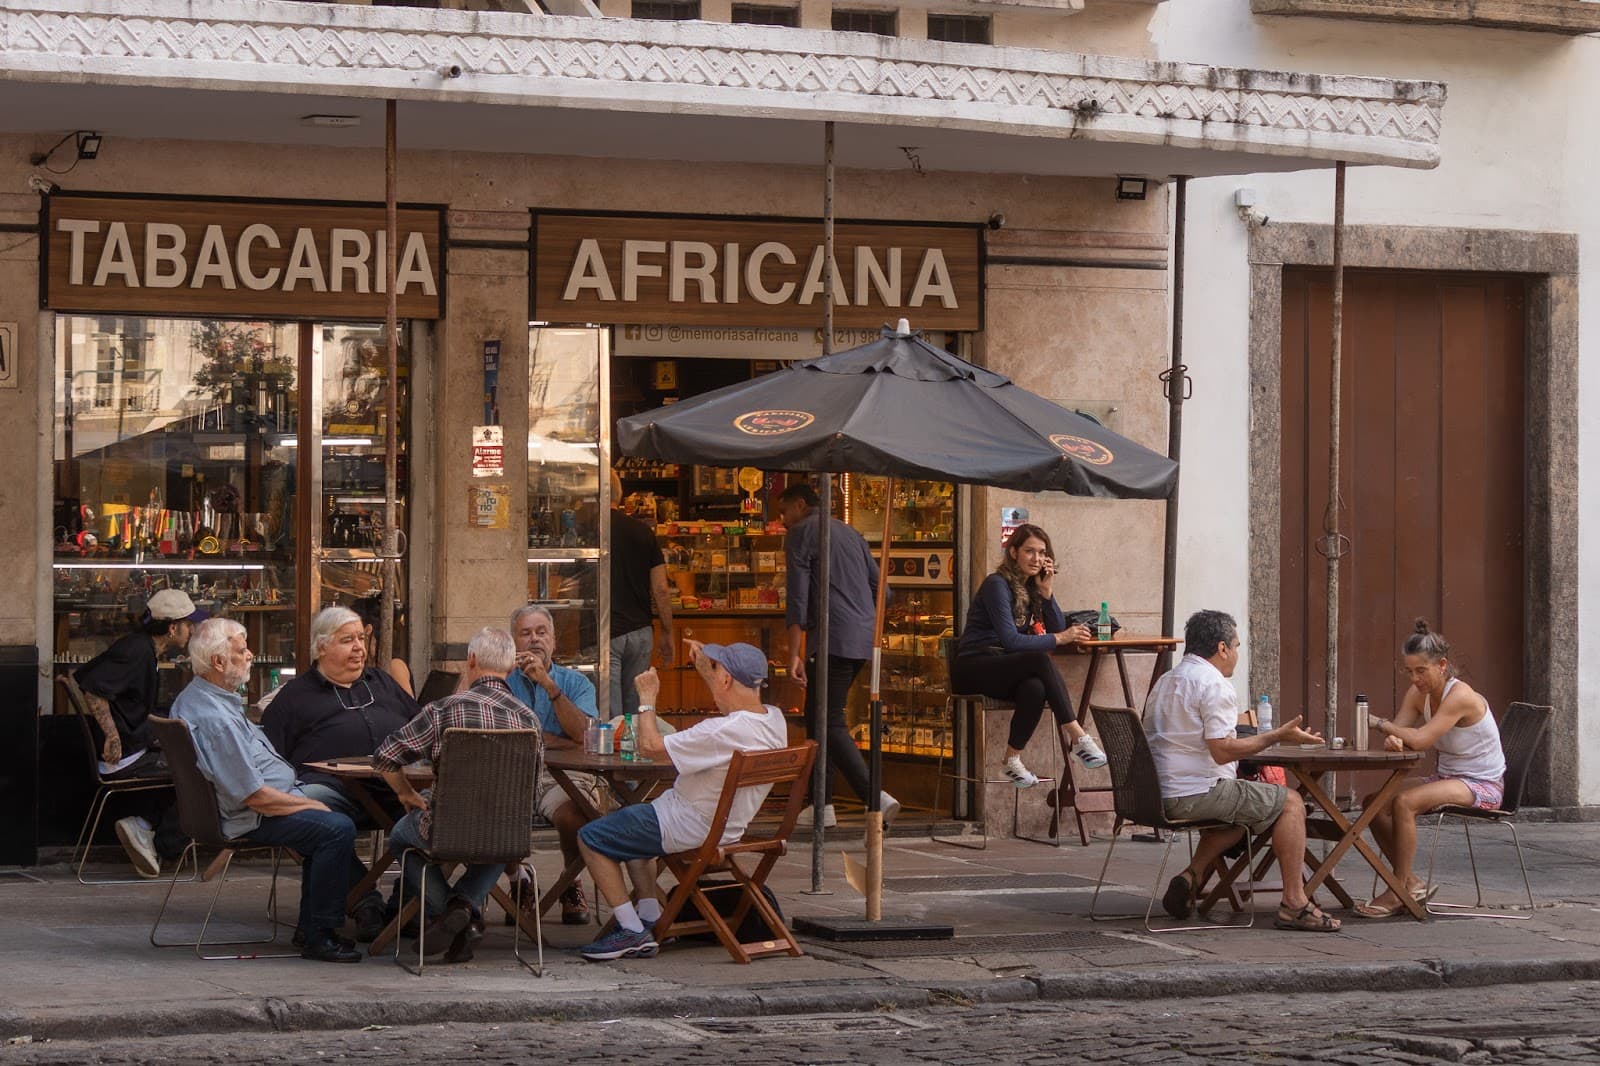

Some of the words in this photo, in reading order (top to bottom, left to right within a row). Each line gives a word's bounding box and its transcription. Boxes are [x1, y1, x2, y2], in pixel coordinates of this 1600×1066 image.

[57, 218, 438, 296] TABACARIA
[562, 238, 959, 309] AFRICANA
[668, 326, 799, 343] @memoriasafricana
[833, 330, 856, 346] (21)
